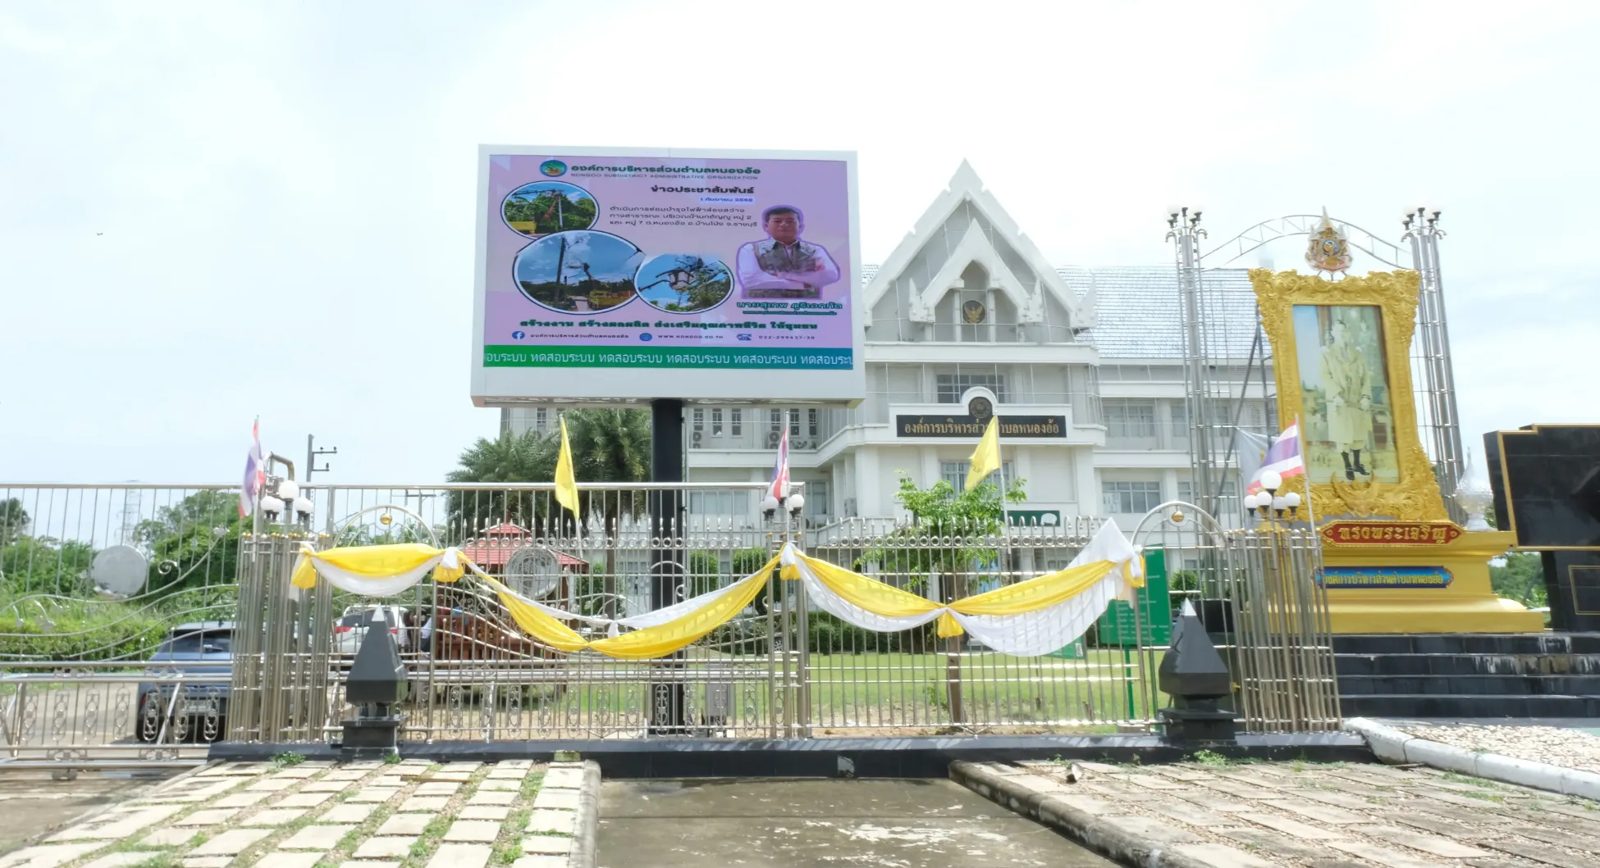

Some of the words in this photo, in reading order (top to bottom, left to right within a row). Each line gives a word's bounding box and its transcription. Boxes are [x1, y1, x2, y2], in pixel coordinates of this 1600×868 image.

[571, 164, 761, 174] องค์การบริหารส่วนตำบลหนองอ้อ
[531, 353, 595, 363] ทดสอบระบบ
[600, 354, 663, 364] ทดสอบระบบ
[667, 354, 729, 364] ทดสอบระบบ
[734, 355, 797, 365] ทดสอบระบบ
[904, 417, 1060, 434] องค์การบริหารส่วำบลหนองอ้อ
[1338, 524, 1448, 544] ทรงพระเจริญ
